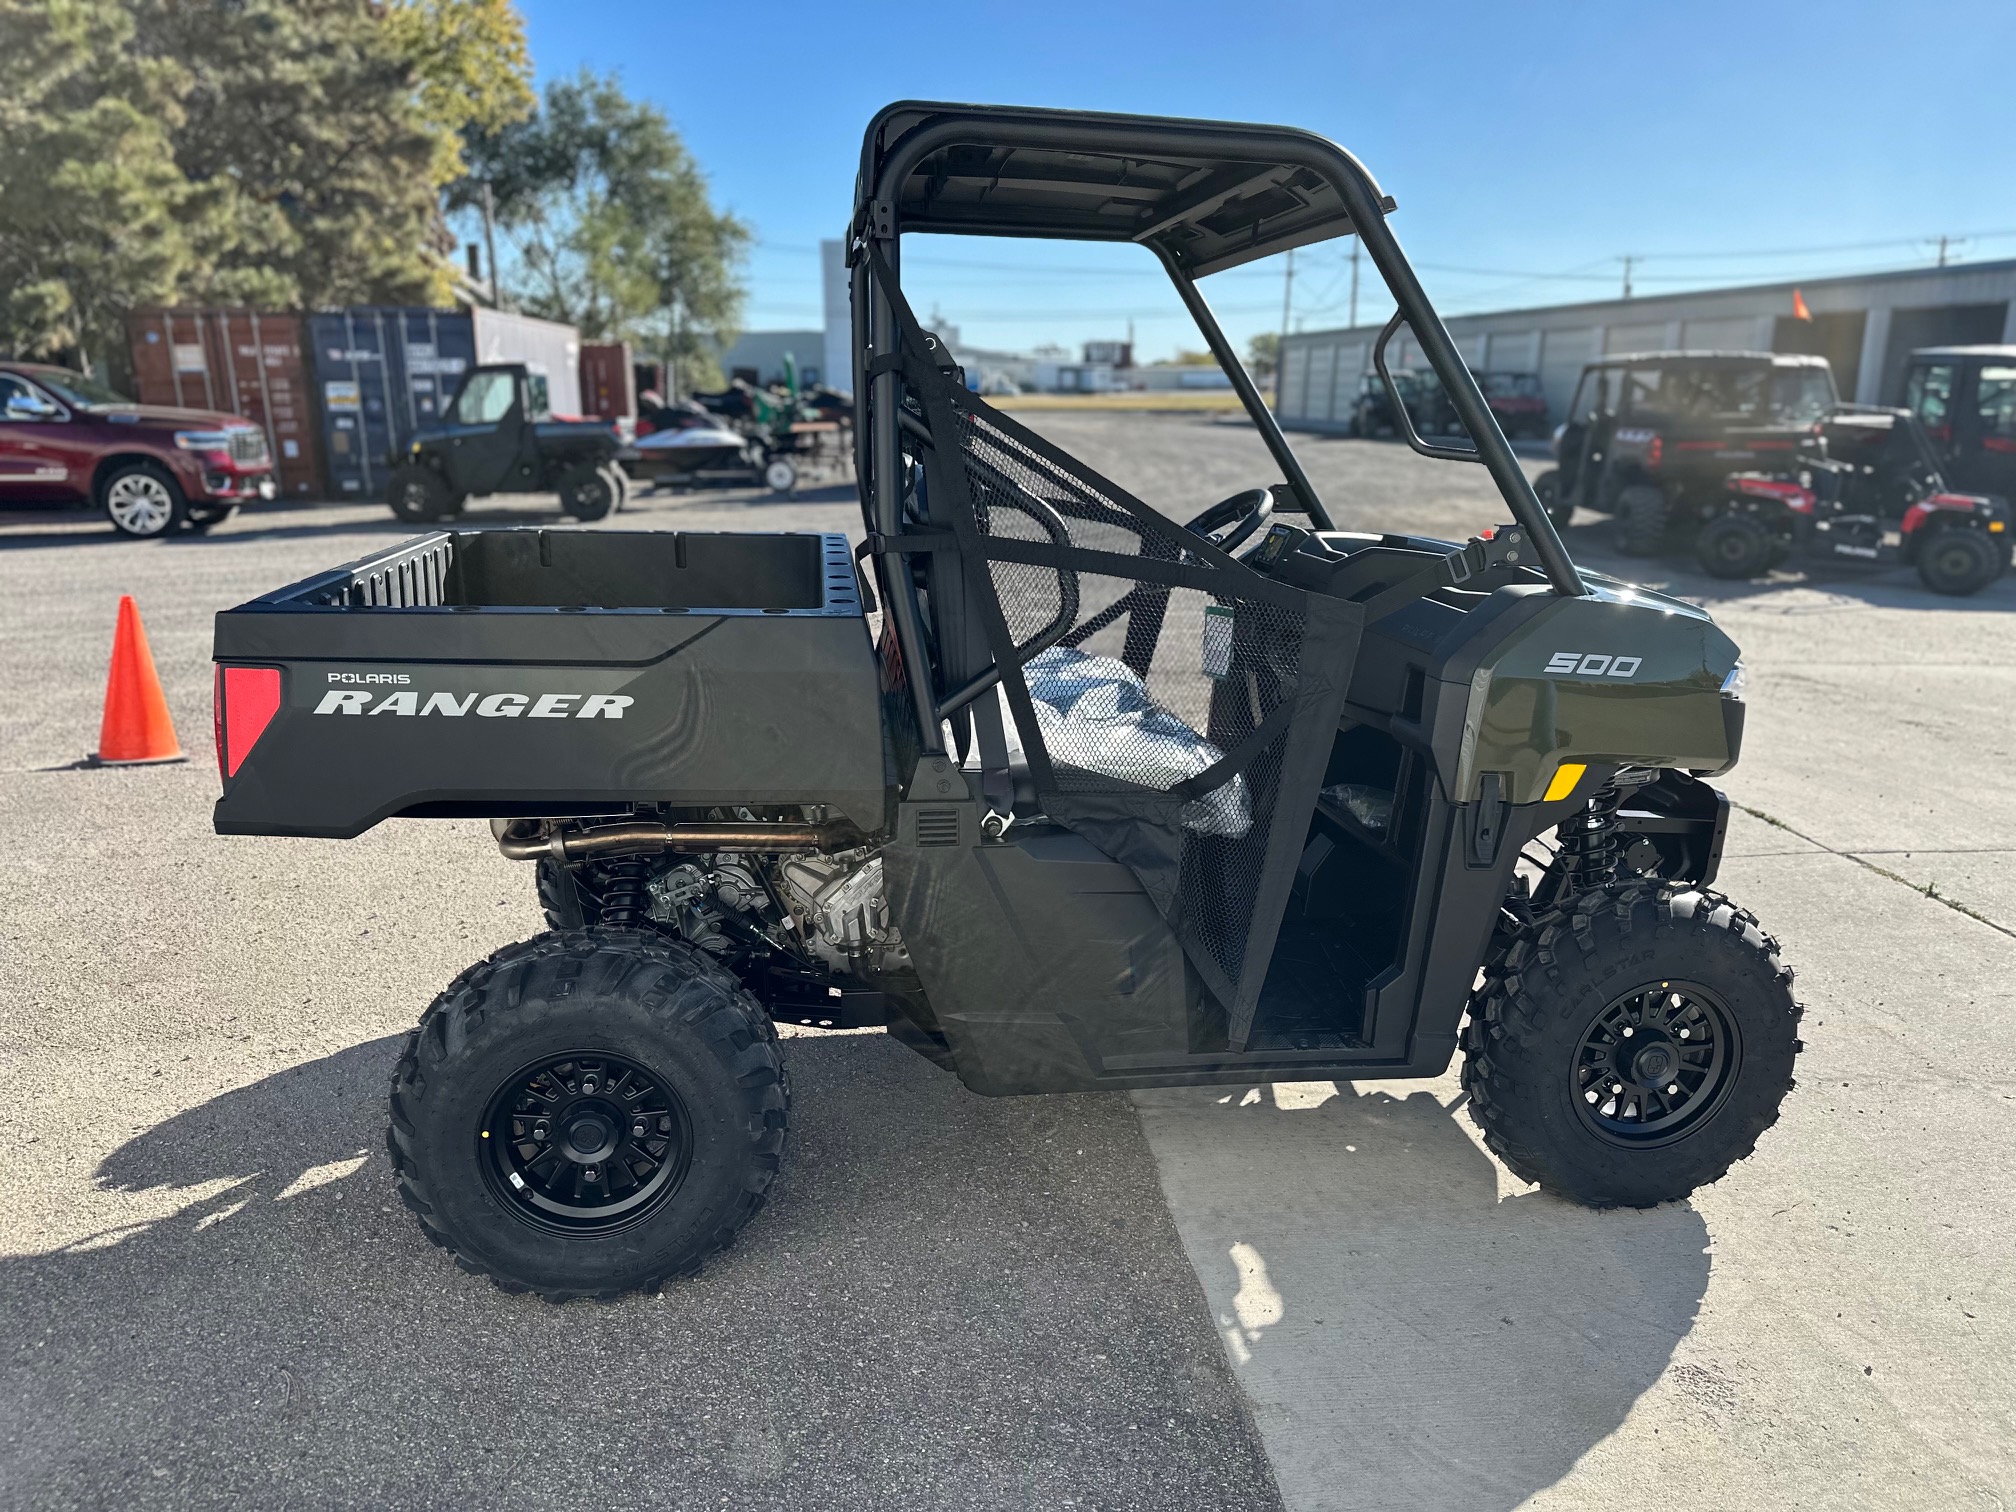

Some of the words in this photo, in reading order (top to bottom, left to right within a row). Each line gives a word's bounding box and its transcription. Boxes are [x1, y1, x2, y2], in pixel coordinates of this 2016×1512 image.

[1543, 652, 1642, 678] 500
[328, 673, 411, 684] POLARIS
[313, 690, 635, 719] RANGER
